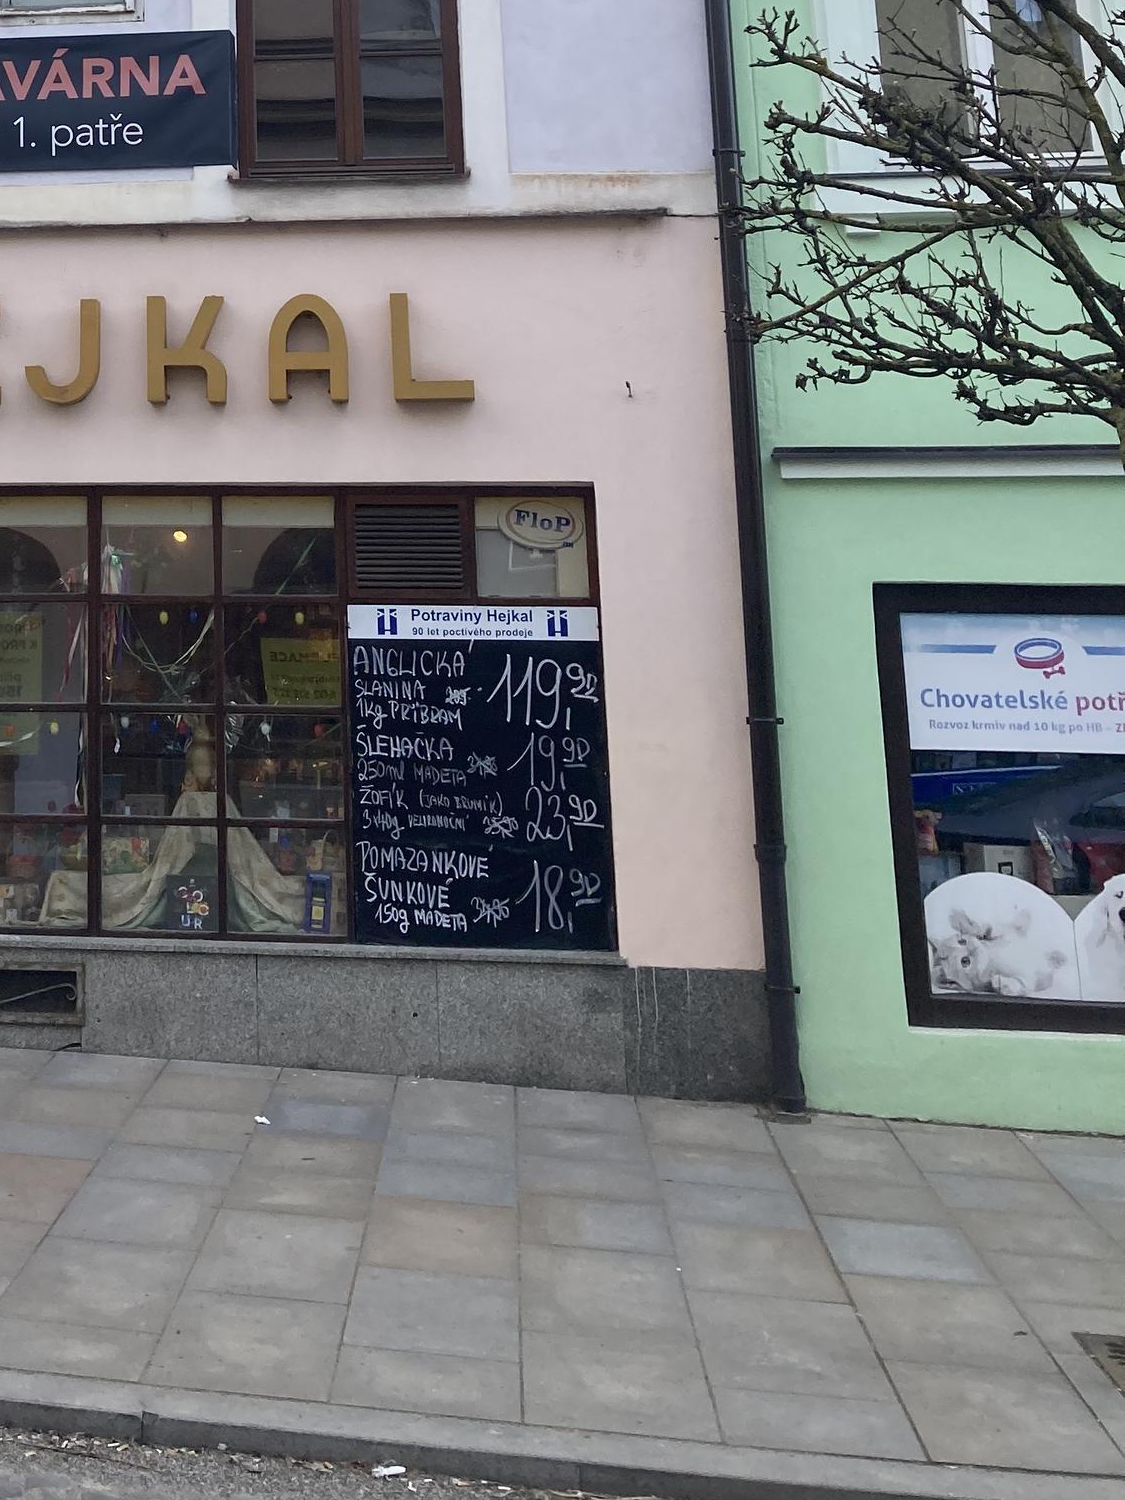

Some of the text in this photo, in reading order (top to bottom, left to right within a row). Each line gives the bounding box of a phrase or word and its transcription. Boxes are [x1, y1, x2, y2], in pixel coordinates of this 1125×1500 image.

[12, 116, 36, 148] 1.
[51, 113, 143, 156] patře
[514, 508, 571, 534] FloP
[411, 609, 533, 624] Potraviny Hejkal
[412, 627, 533, 638] 90 let poctivého prodeje
[355, 679, 426, 701] SLANINA
[920, 687, 1069, 710] Chovatelské
[929, 719, 969, 731] Rozvoz
[971, 720, 1006, 732] krmiv
[1009, 721, 1031, 732] nad
[1034, 722, 1049, 731] 10
[1051, 721, 1066, 735] kg
[1068, 724, 1084, 735] po
[356, 725, 454, 761] ŠLEHAČKA
[413, 762, 467, 788] MADETA
[364, 871, 455, 910] ŠUNKOVÉ
[374, 902, 410, 934] 150g
[414, 908, 467, 932] MADETA
